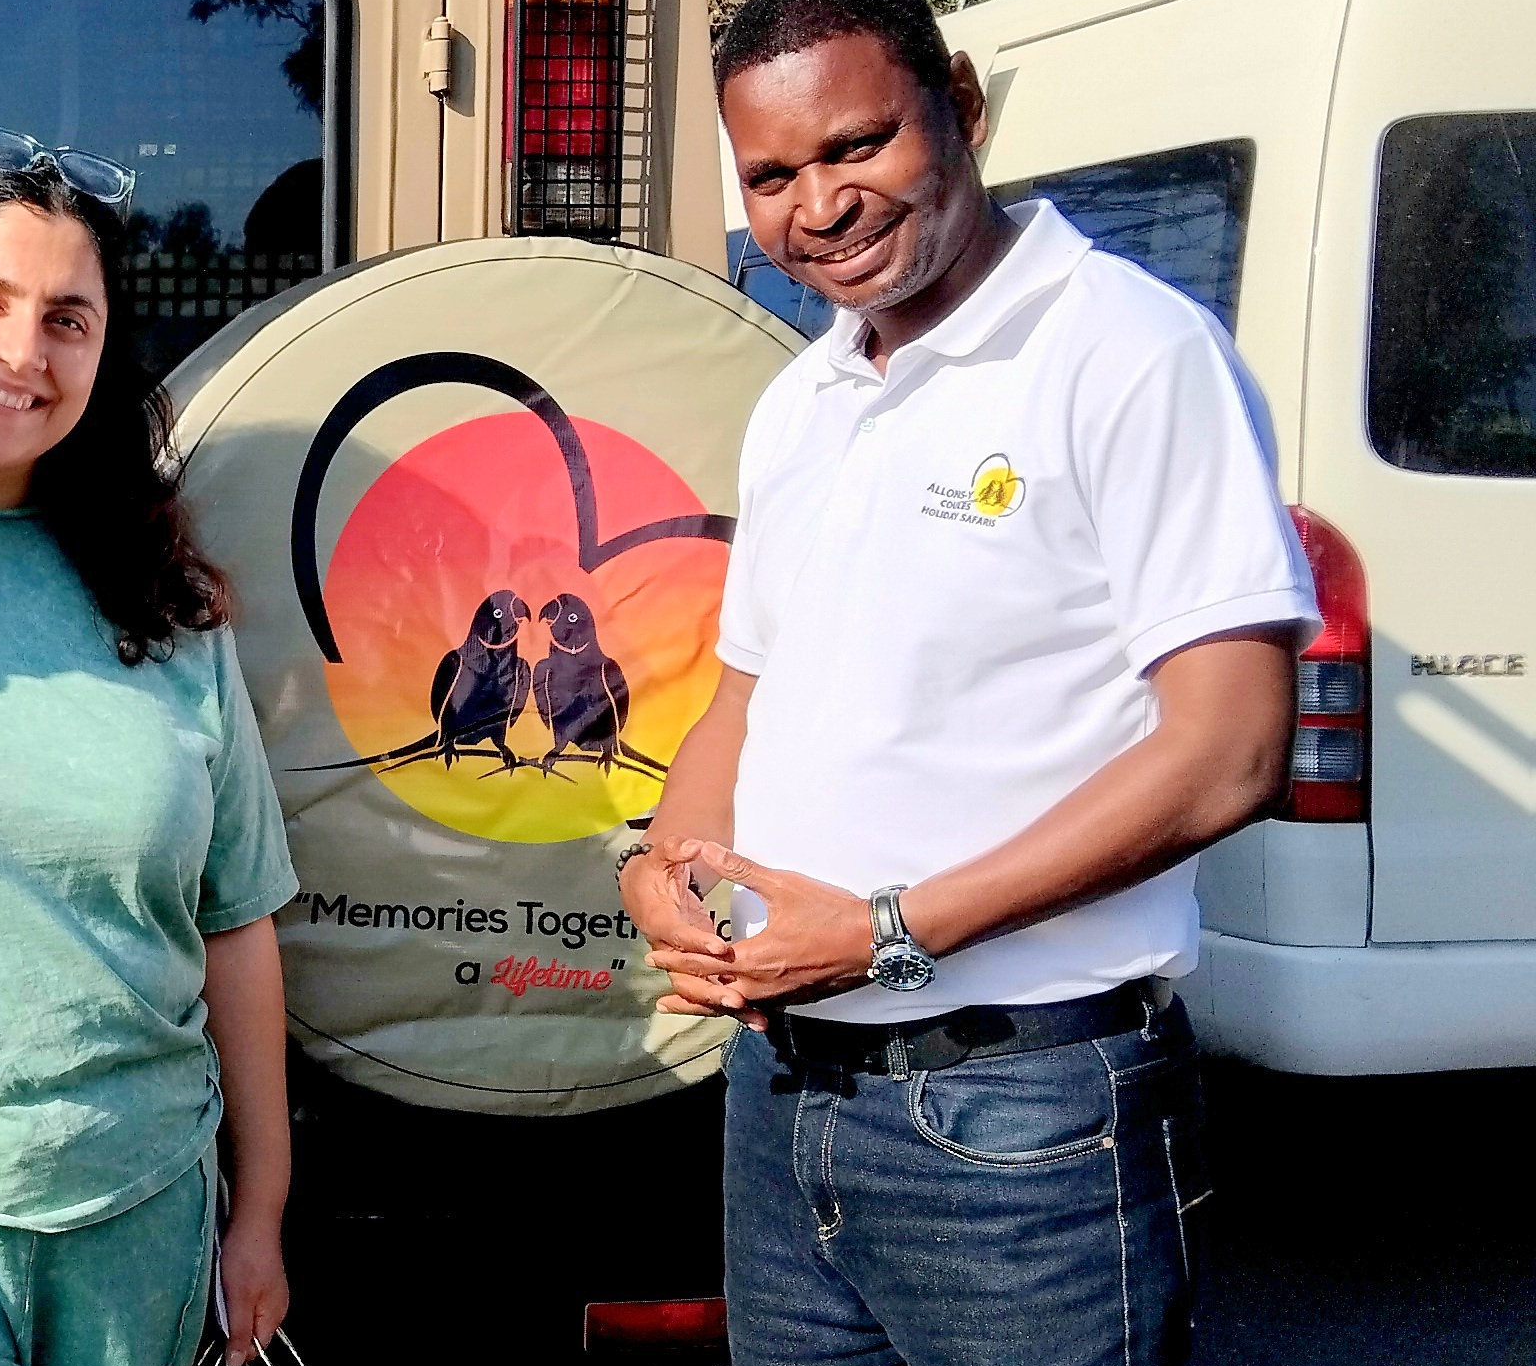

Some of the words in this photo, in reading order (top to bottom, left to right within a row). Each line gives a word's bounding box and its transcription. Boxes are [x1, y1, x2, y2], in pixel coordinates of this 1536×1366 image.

[926, 482, 975, 500] ALLONS-Y
[921, 505, 959, 521] HOLIDAY
[959, 513, 996, 528] SAFARIS
[1410, 653, 1527, 677] HIACE
[454, 961, 481, 986] a
